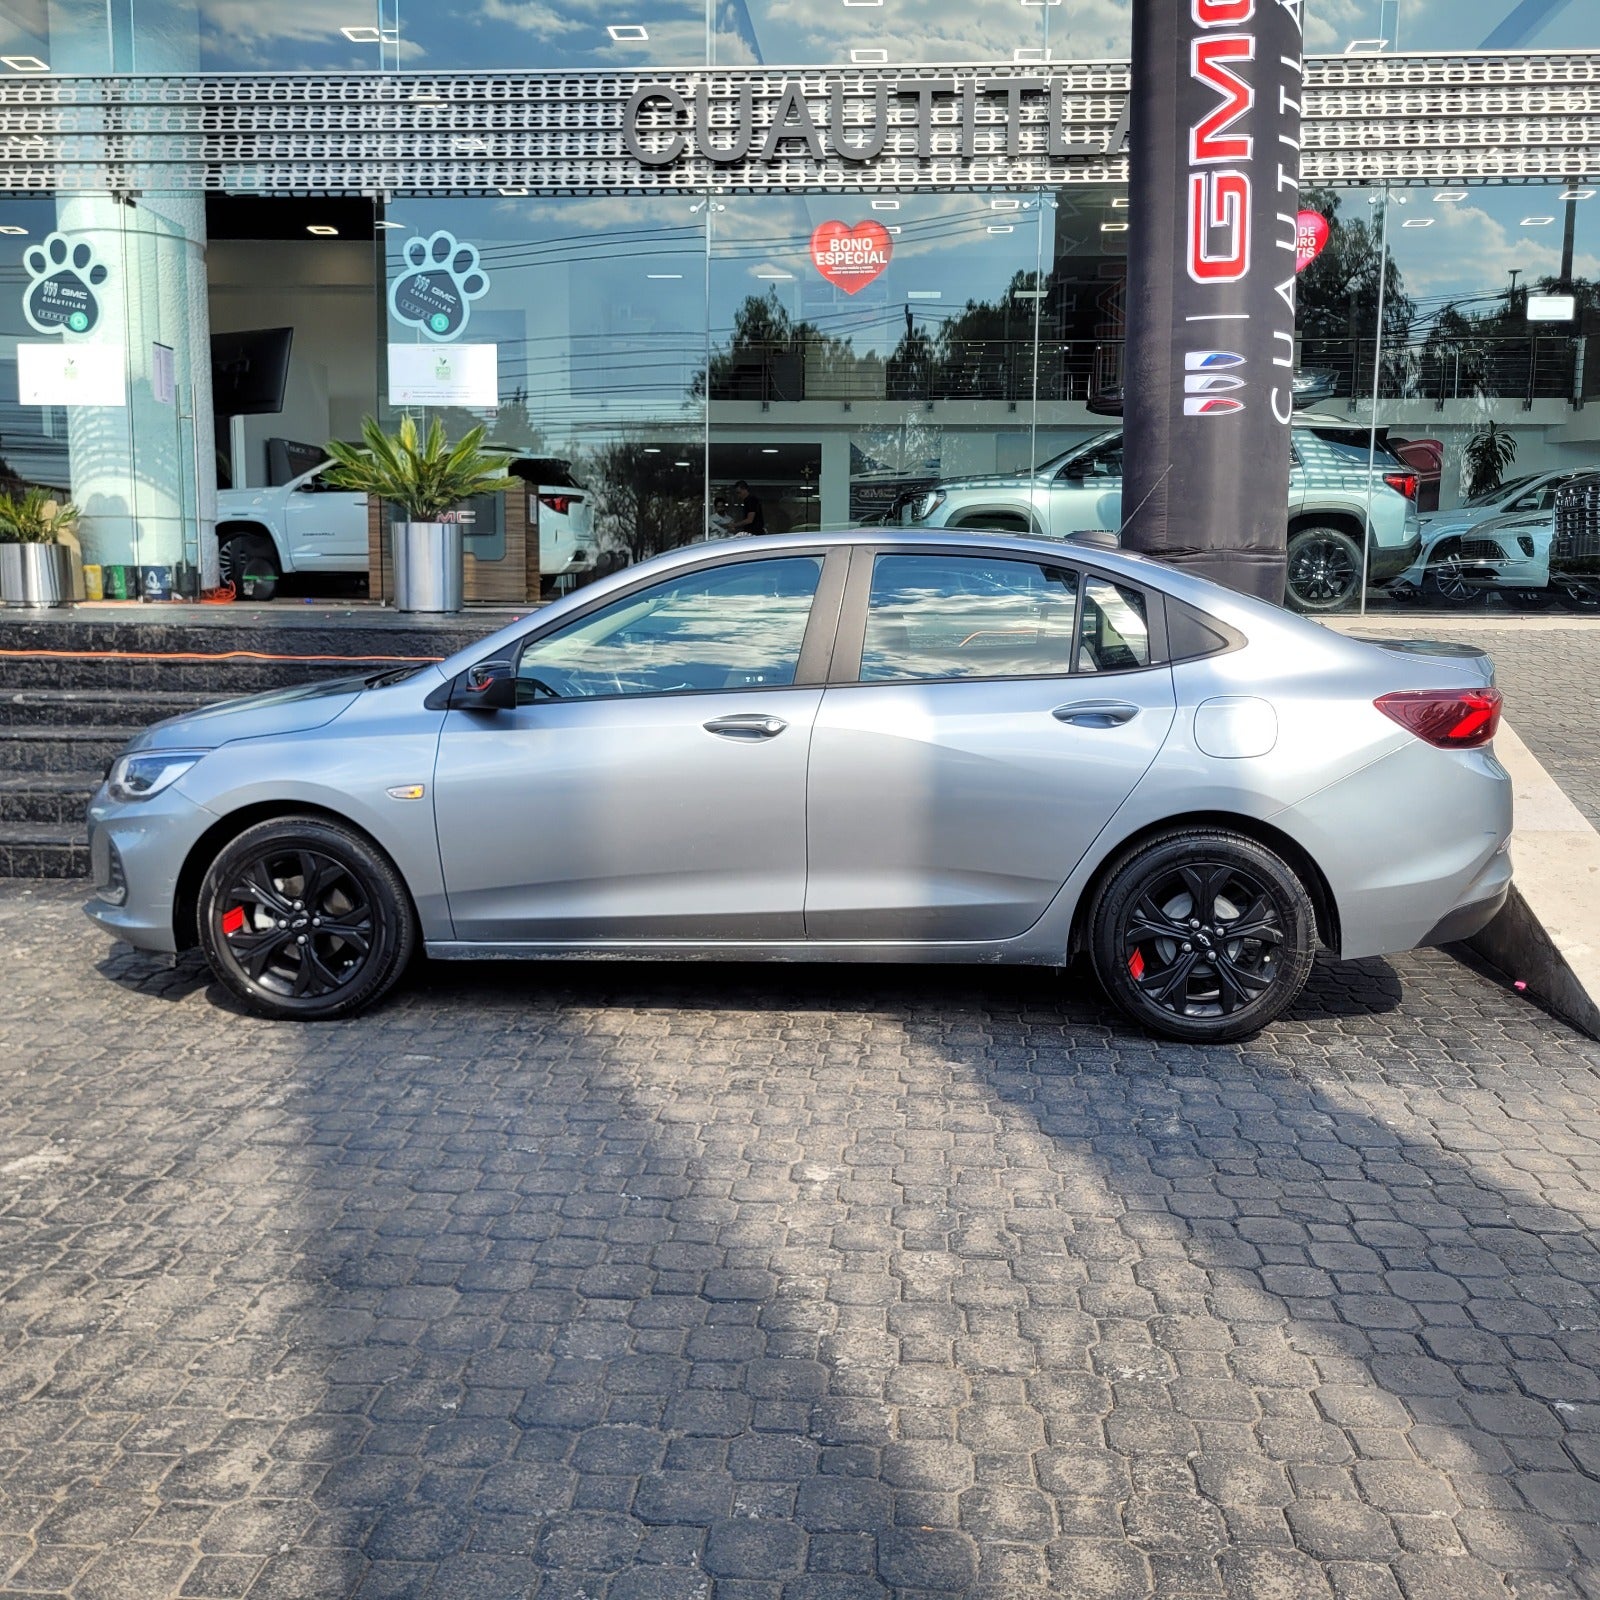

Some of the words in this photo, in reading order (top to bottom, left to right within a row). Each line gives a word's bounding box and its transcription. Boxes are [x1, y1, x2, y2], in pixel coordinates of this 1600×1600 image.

[1186, 0, 1256, 284] GM
[1300, 226, 1316, 237] DE
[829, 238, 873, 252] BONO
[816, 250, 888, 265] ESPECIAL
[60, 288, 88, 300] GMC
[431, 286, 457, 304] GMC
